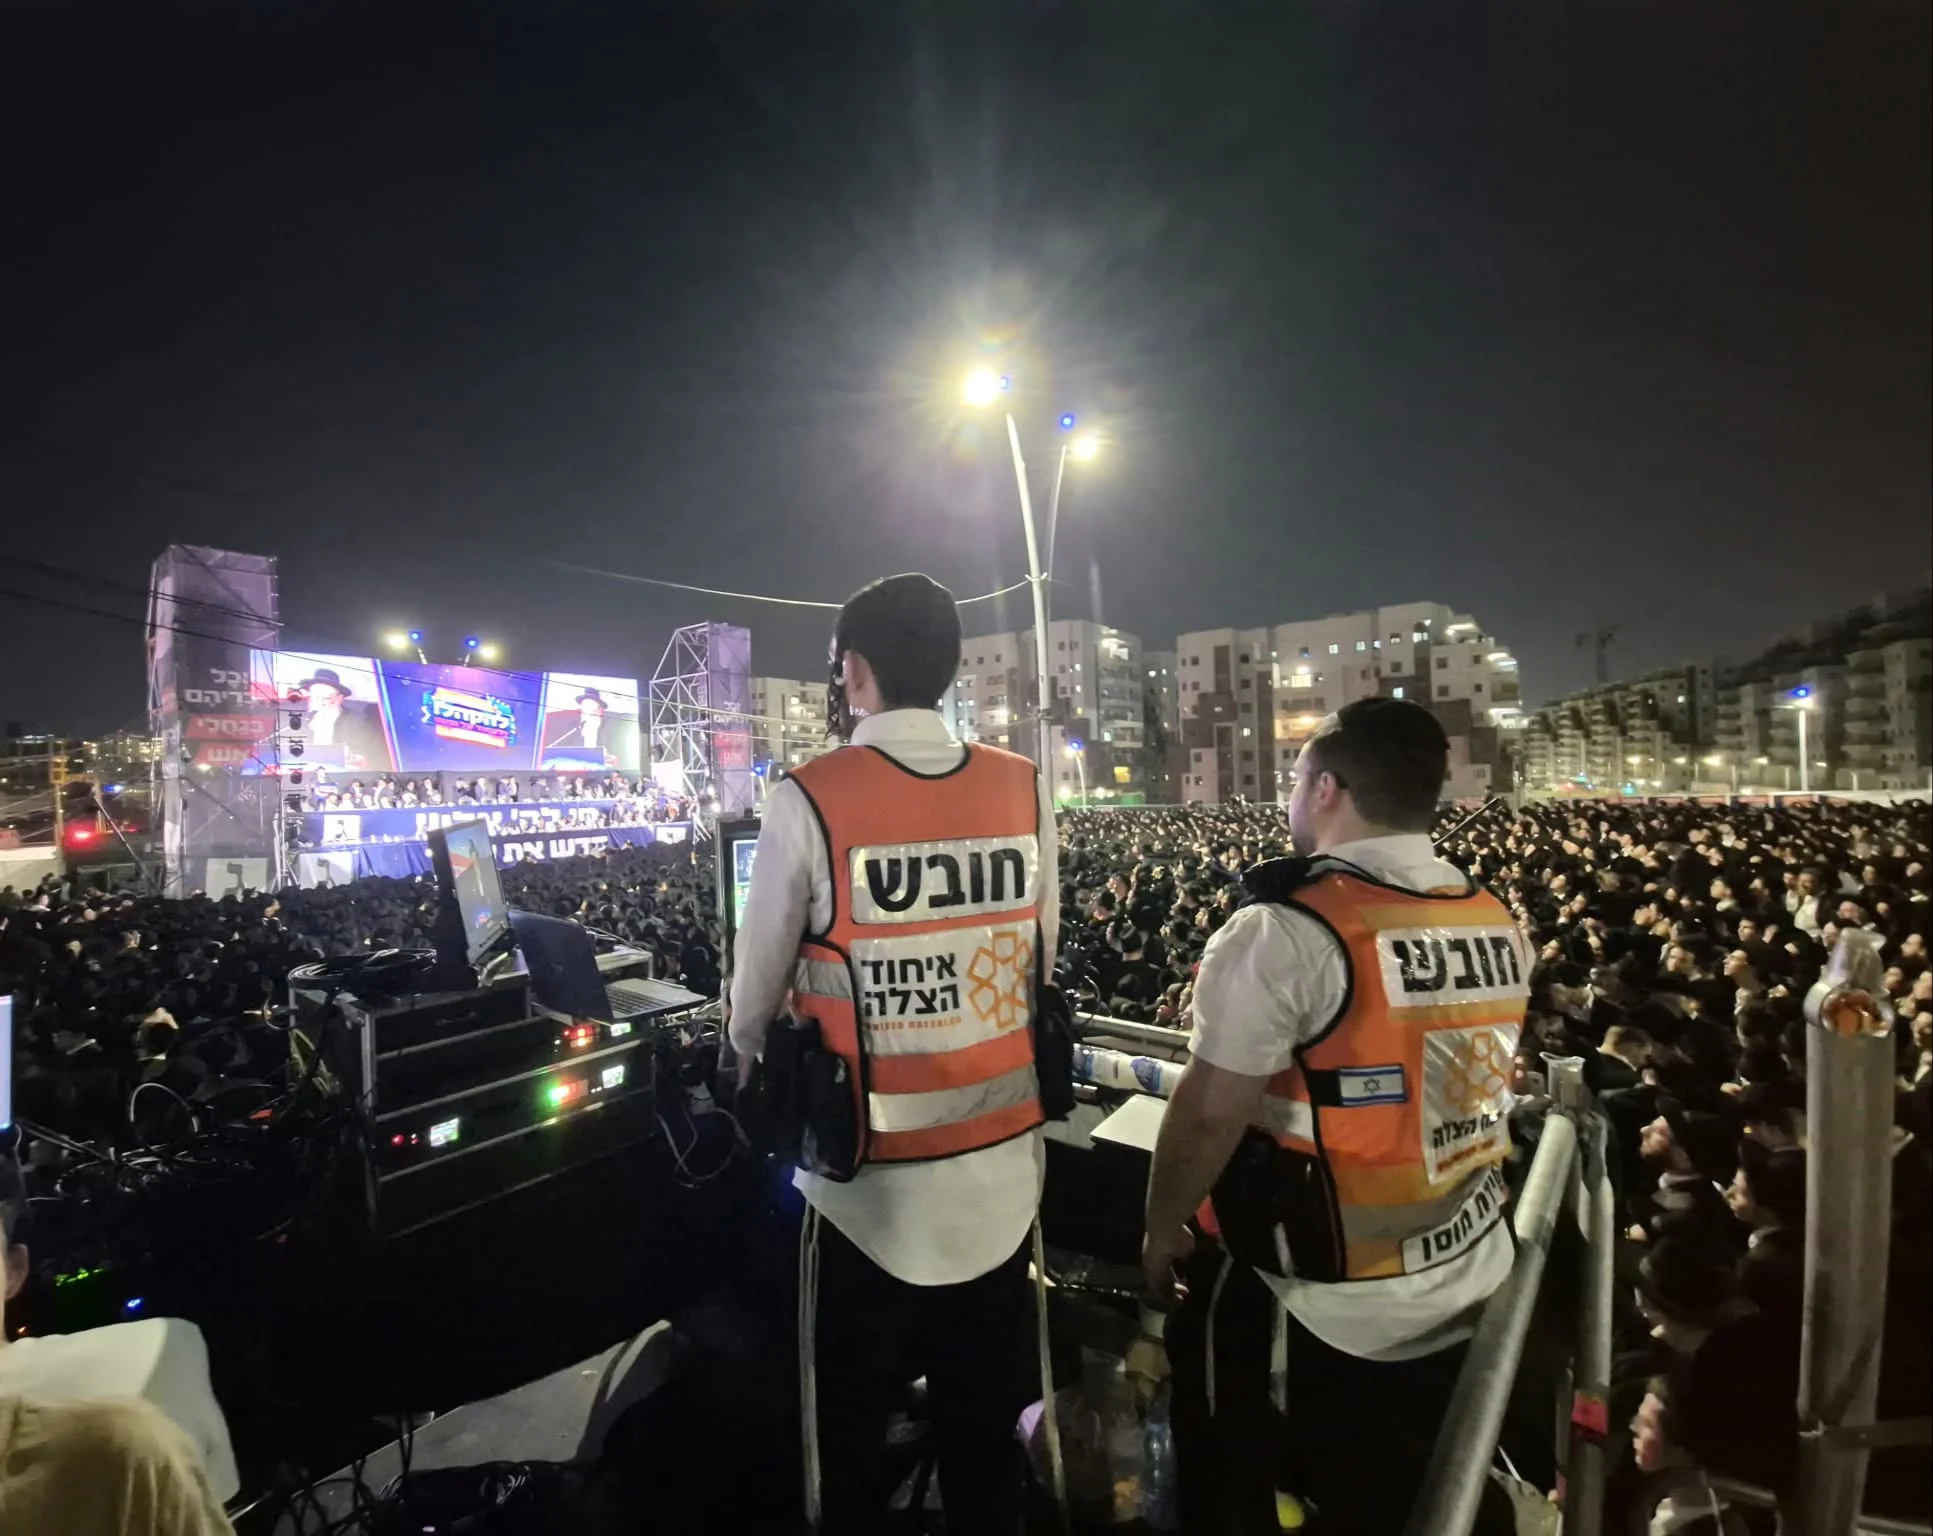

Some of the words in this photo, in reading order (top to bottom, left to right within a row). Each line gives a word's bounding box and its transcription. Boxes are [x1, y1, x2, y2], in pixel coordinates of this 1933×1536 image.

[503, 841, 545, 864] את
[865, 848, 1025, 912] חובש
[861, 953, 957, 985] איחוד
[1392, 937, 1520, 992] חובש
[864, 984, 960, 1016] הצלה
[1433, 1118, 1476, 1149] הצלה
[1422, 1208, 1473, 1262] חוסן
